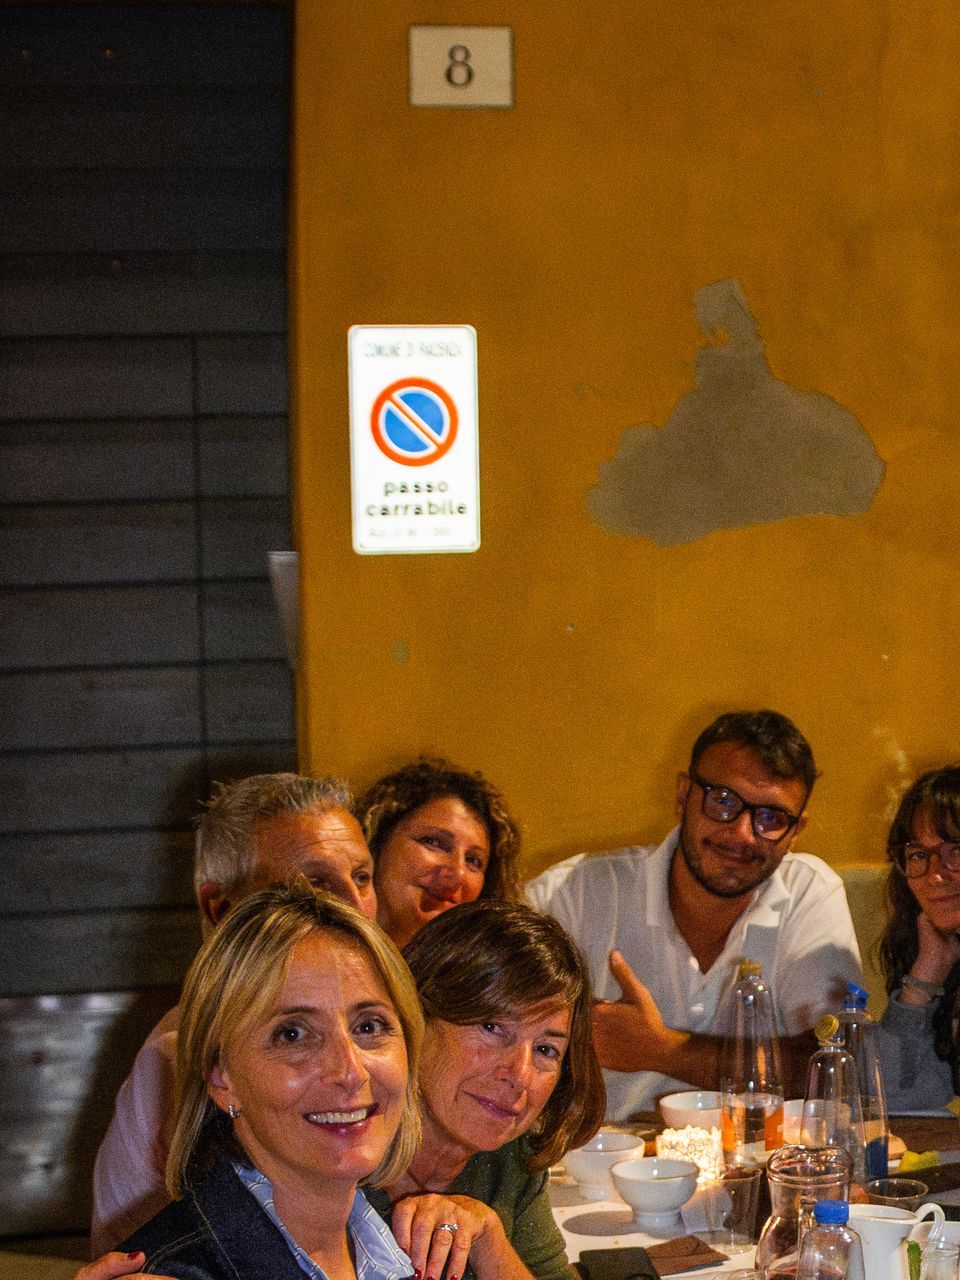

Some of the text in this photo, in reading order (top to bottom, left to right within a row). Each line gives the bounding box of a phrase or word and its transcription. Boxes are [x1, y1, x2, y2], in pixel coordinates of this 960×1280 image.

[444, 43, 474, 87] 8
[383, 481, 449, 497] passo
[365, 499, 468, 517] carrabile
